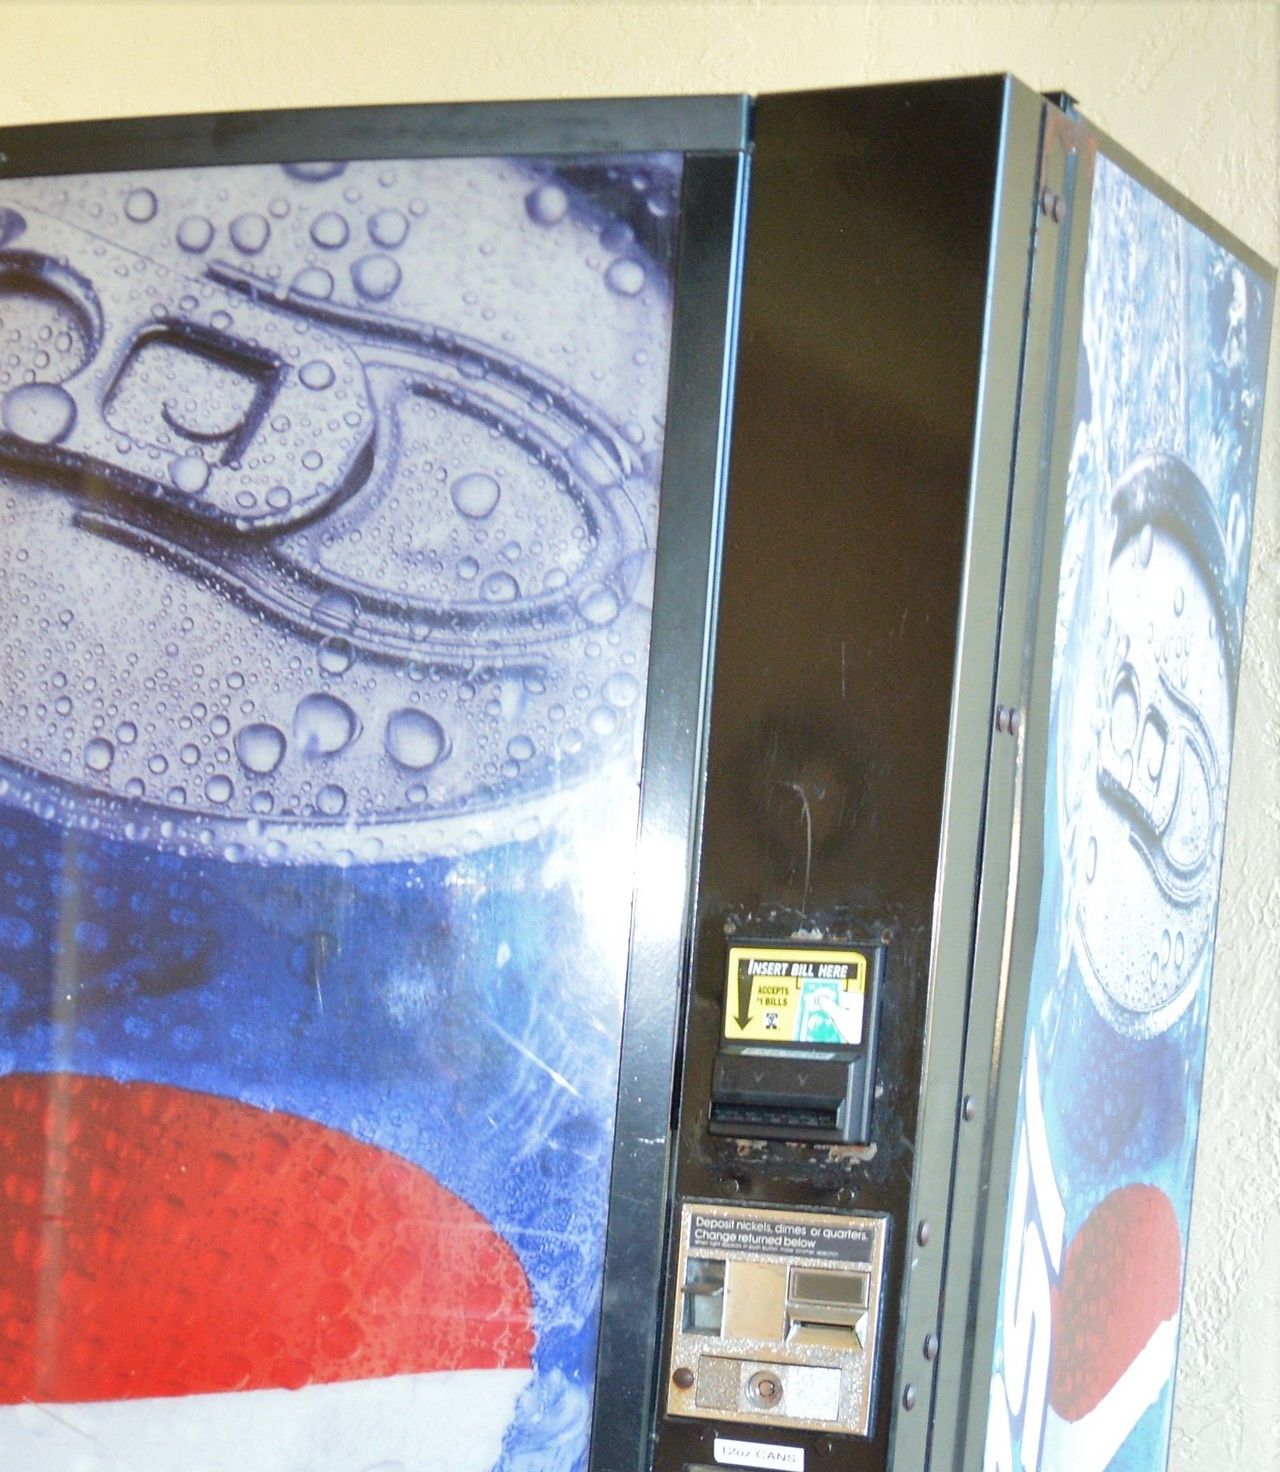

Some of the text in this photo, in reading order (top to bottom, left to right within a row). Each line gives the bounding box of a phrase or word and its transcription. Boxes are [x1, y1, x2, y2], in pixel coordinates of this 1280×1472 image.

[748, 959, 848, 978] INSERT BILL HERE
[758, 985, 789, 995] ACCEPTS
[765, 998, 787, 1007] BILLS
[696, 1215, 869, 1241] Deposit nickels, dimes or quarters.
[694, 1229, 737, 1244] Change
[738, 1232, 783, 1246] returned
[784, 1237, 817, 1249] below
